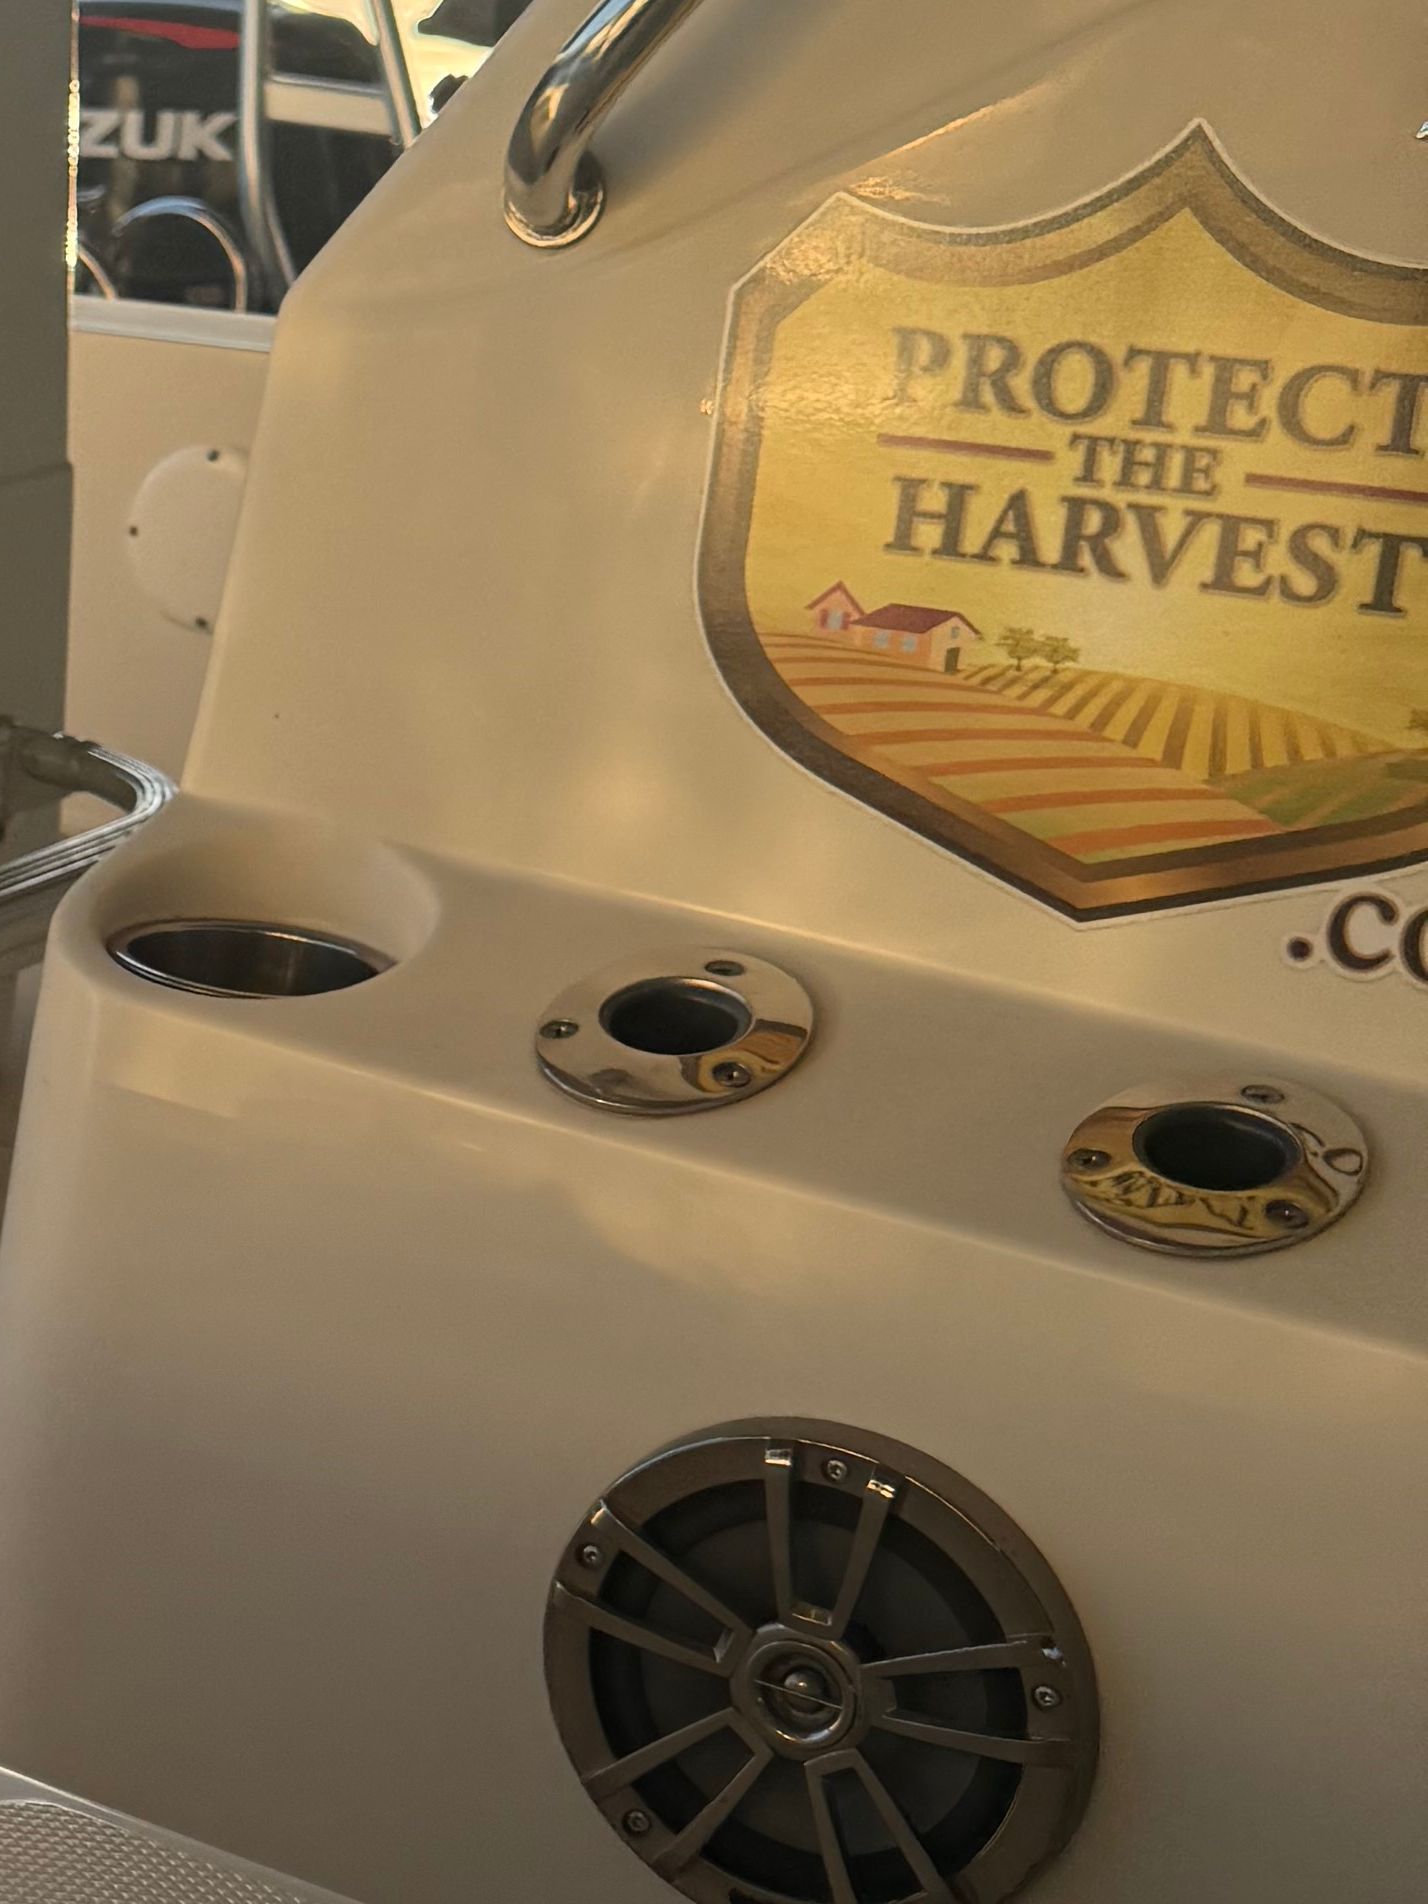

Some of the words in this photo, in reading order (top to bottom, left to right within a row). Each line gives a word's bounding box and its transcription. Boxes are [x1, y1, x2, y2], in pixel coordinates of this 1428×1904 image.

[80, 108, 237, 161] ZUK
[890, 327, 1428, 458] PROTECT
[1068, 432, 1222, 498] THE
[883, 476, 1428, 617] HARVEST
